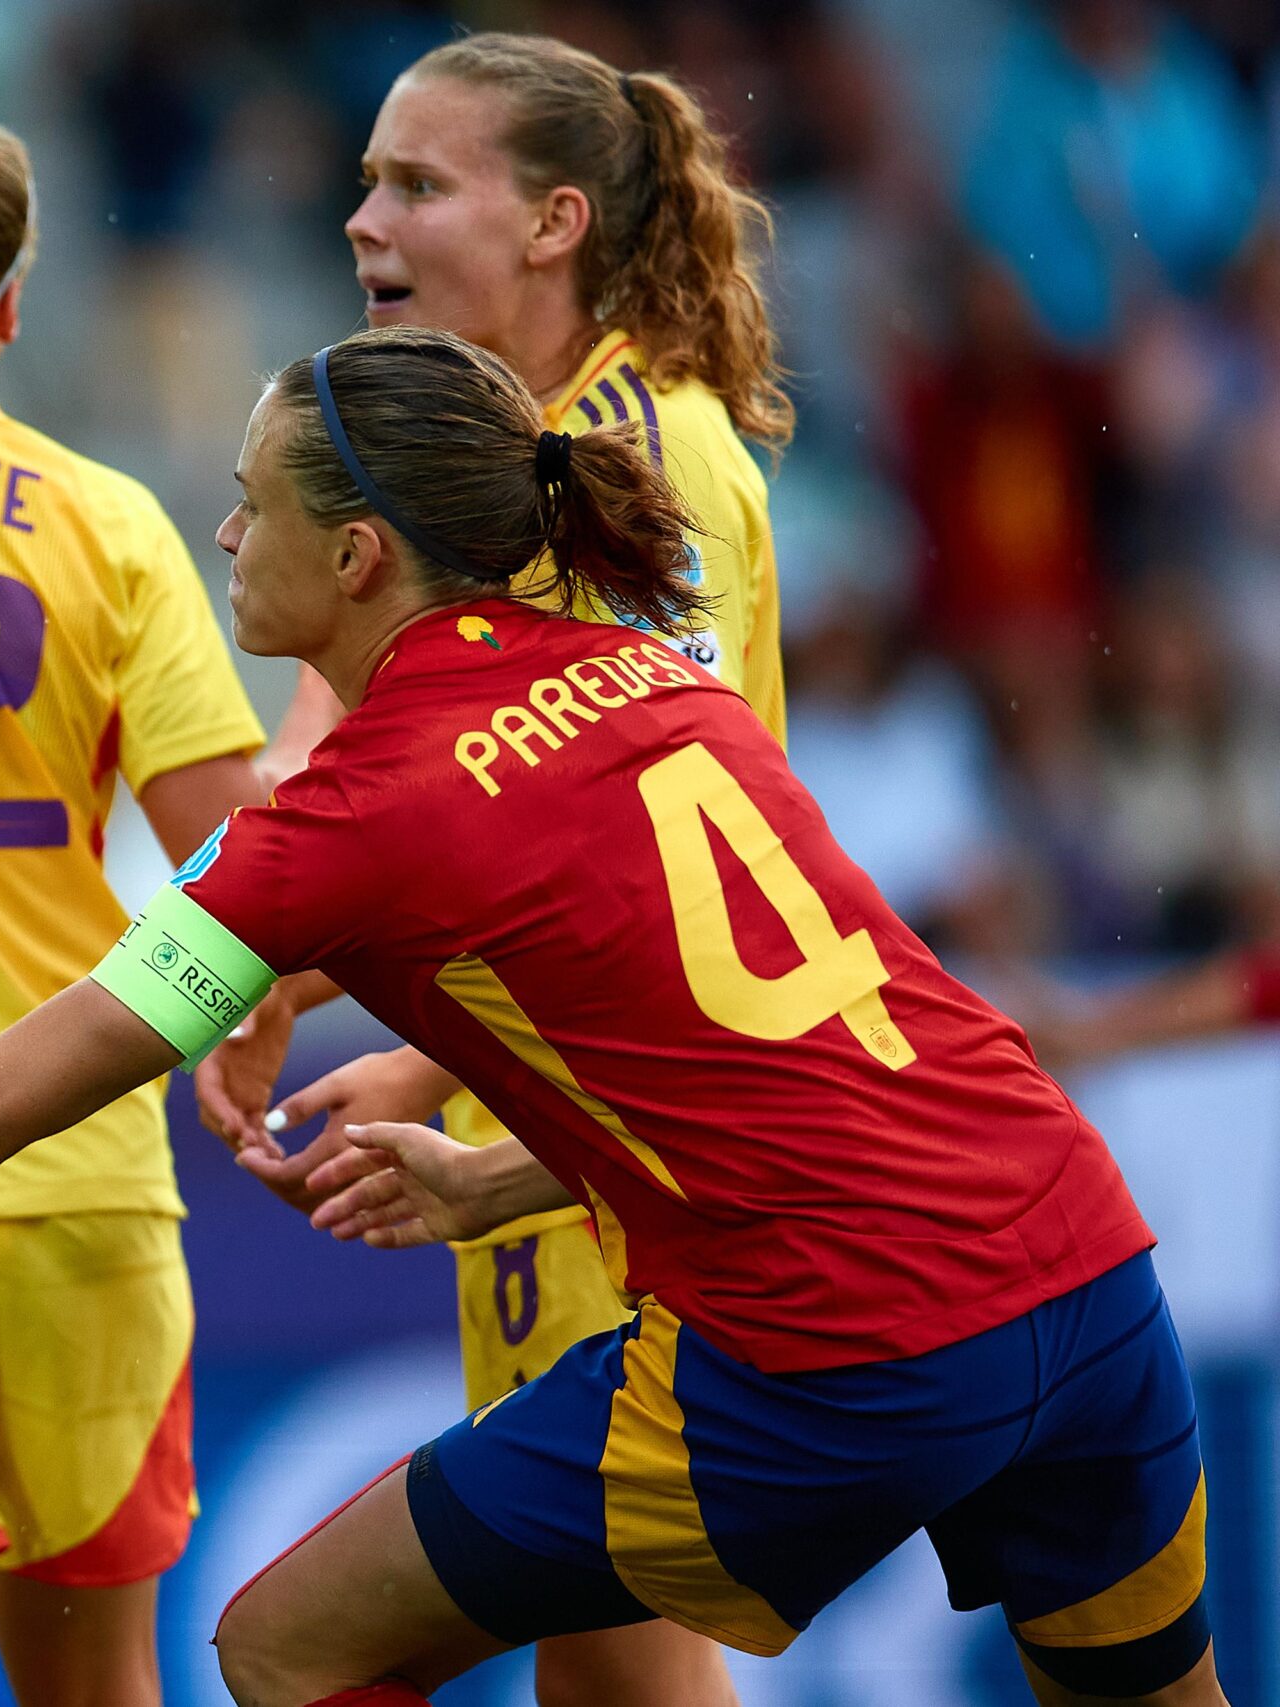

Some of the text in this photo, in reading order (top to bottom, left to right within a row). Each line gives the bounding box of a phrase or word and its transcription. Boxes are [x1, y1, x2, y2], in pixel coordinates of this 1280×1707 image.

[454, 642, 699, 798] PAREDES
[637, 741, 918, 1072] 4
[178, 965, 243, 1025] RESPEC
